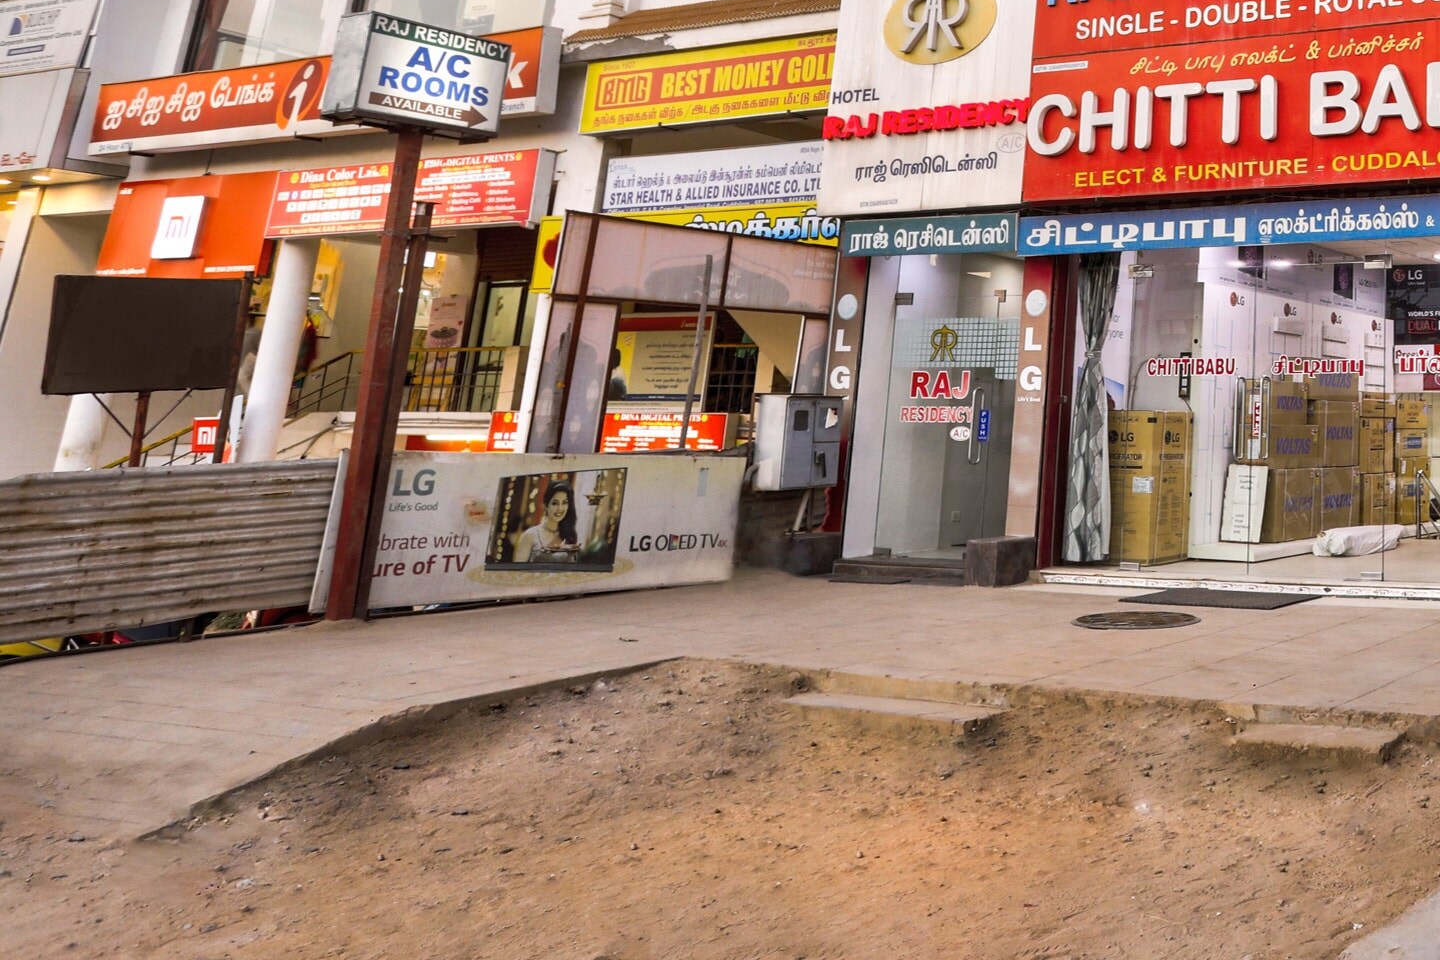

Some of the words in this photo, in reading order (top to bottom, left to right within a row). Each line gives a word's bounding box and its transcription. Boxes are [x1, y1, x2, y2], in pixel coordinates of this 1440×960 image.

[1075, 11, 1165, 40] SINGLE
[375, 16, 409, 36] RAJ
[414, 26, 509, 58] RESIDENCY
[1305, 40, 1321, 59] &
[406, 47, 471, 78] A/C
[378, 66, 489, 107] ROOMS
[660, 68, 710, 99] BEST
[712, 58, 785, 93] MONEY
[102, 82, 205, 131] ஐசிஐசிஐ
[210, 72, 275, 108] பேங்க்
[832, 88, 880, 105] HOTEL
[381, 95, 462, 120] AVAILABLE
[1027, 74, 1278, 157] CHITTI
[822, 112, 877, 140] RAJ
[882, 96, 1031, 138] RESIDENCY
[300, 171, 324, 183] Dina
[326, 168, 356, 181] Color
[855, 160, 887, 182] ராஜ்
[1073, 166, 1145, 189] ELECT
[1151, 165, 1167, 183] &
[1174, 157, 1308, 182] FURNITURE
[610, 192, 634, 206] STAR
[636, 189, 673, 204] HEALTH
[675, 188, 682, 201] &
[685, 185, 719, 201] ALLIED
[722, 180, 781, 198] INSURANCE
[783, 179, 800, 194] CO.
[1425, 215, 1435, 227] &
[1408, 270, 1423, 280] LG
[1408, 320, 1437, 331] DUAL
[1020, 327, 1042, 391] LG
[1147, 357, 1237, 377] CHITTIBABU
[910, 370, 971, 399] RAJ
[1277, 396, 1303, 410] VOLTAS
[640, 413, 671, 422] DIGITAL
[900, 406, 973, 423] RESIDENCY
[953, 428, 969, 439] A/C
[1121, 433, 1134, 442] LG
[1327, 426, 1353, 440] VOLTAS
[1276, 438, 1312, 455] VOLTAS
[392, 469, 435, 497] LG
[388, 501, 412, 513] Life's
[415, 500, 438, 513] Good
[1325, 493, 1354, 510] VOLTAS
[434, 532, 470, 549] with
[629, 536, 652, 553] LG
[655, 534, 697, 552] OLED
[412, 554, 435, 576] of
[441, 554, 471, 574] TV
